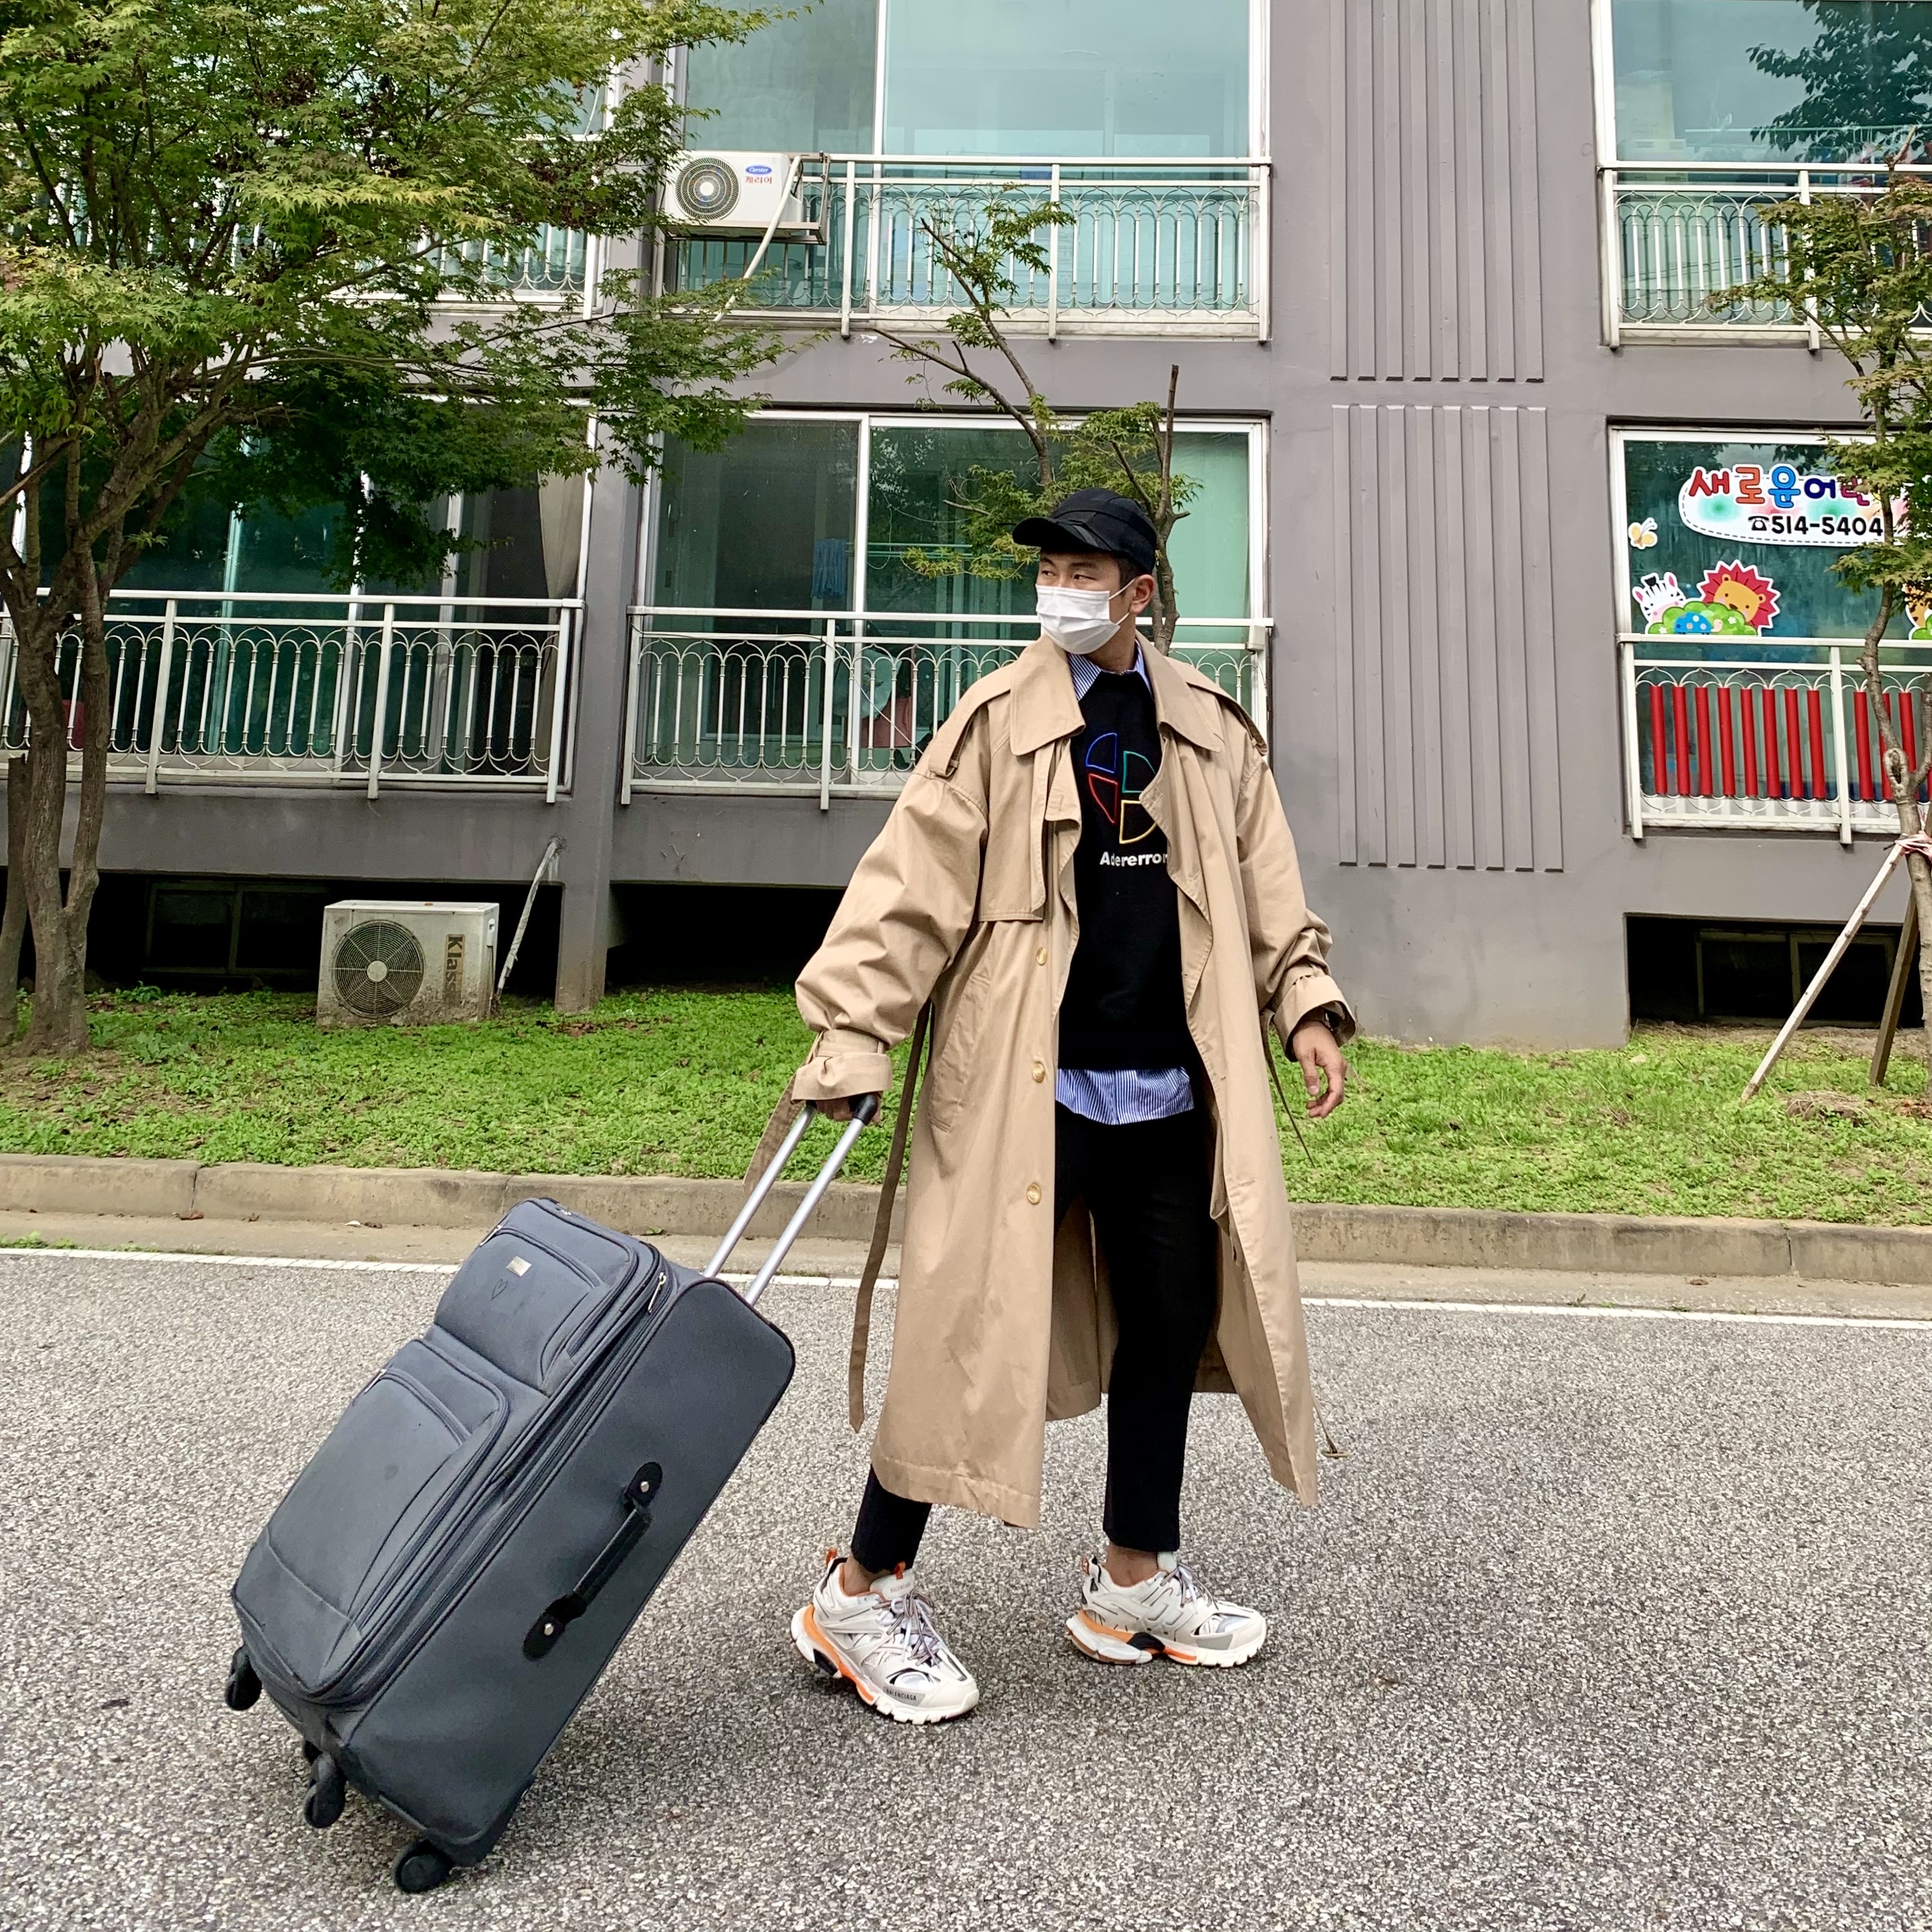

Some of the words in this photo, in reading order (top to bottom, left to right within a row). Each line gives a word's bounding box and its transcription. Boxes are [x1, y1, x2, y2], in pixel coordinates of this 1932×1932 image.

[1688, 465, 1870, 509] 새로운어린
[1772, 516, 1884, 536] 514-5404
[1100, 851, 1168, 867] Adererror
[444, 936, 463, 998] Klass
